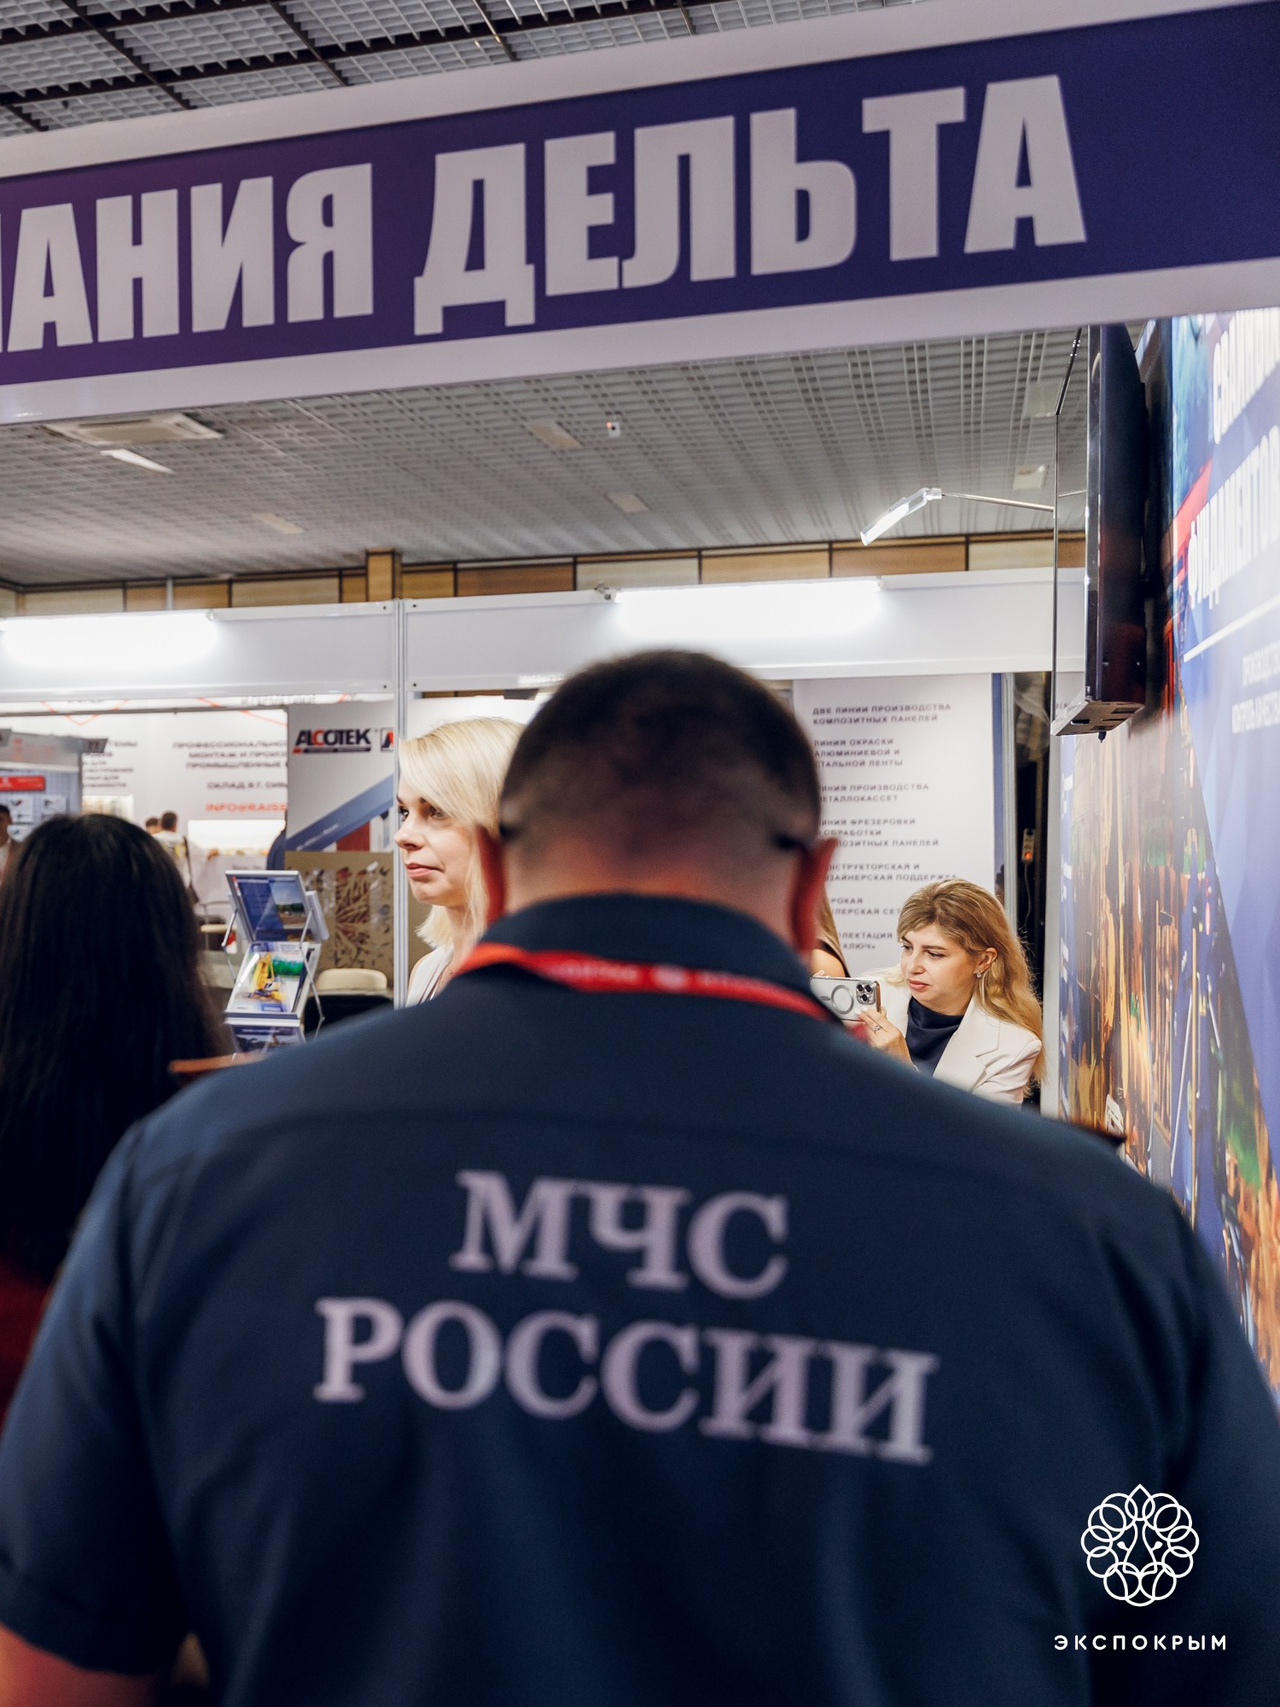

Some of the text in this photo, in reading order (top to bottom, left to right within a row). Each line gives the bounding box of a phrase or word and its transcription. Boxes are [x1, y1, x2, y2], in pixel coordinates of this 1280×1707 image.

[413, 74, 1088, 336] ДЕЛЬТА
[812, 704, 951, 716] ДВЕ ЛИНИИ ПРОИЗВОДСТВА
[813, 714, 938, 725] КОМПОЗИТНЫХ ПАНЕЛЕЙ
[295, 728, 372, 747] ALCOTEK
[814, 738, 894, 747] ЛИНИЯ ОКРАСКИ
[814, 749, 891, 757] АЛЮМИНИЕВОЙ
[849, 783, 929, 792] ПРОИЗВОДСТВА
[849, 818, 916, 826] ФРЕЗЕРОВКИ
[892, 838, 939, 846] ПАНЕЛЕЙ
[829, 863, 910, 871] НСТРУКТОРСКАЯ
[825, 873, 893, 881] ИЗАЙНЕРСКАЯ
[839, 932, 893, 940] ЛЕКТАЦИЯ
[447, 1169, 790, 1300] МЧС
[312, 1296, 940, 1466] РОССИИ
